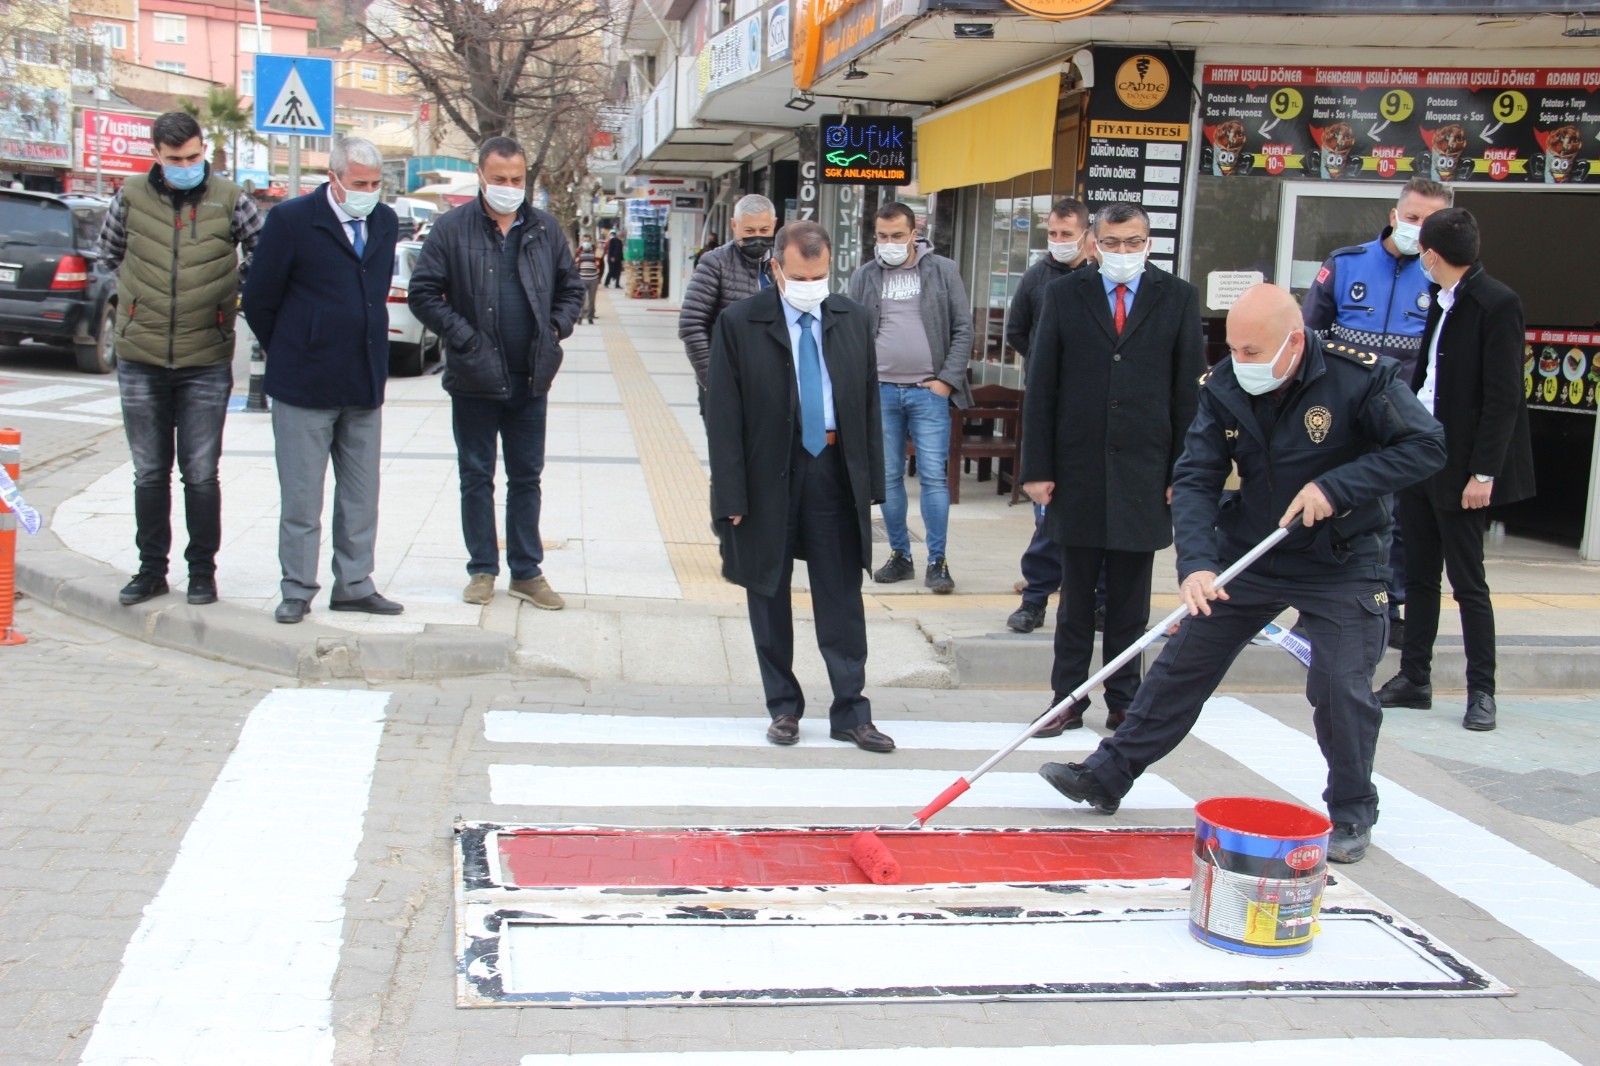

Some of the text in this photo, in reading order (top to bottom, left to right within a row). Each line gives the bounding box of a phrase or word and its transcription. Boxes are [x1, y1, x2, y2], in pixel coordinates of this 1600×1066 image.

[1211, 67, 1302, 83] HATAY USULÜ DÖNER
[1315, 67, 1418, 84] İSKENDERUN USULÜ DÖNER
[1426, 69, 1535, 86] ANTAKYA USULÜ DÖNER
[1546, 72, 1580, 86] ADANA
[1118, 81, 1166, 92] CADDE
[1207, 93, 1237, 103] Patates
[1245, 94, 1268, 104] Marul
[1275, 92, 1290, 114] 9
[1314, 95, 1336, 105] Patates
[1386, 93, 1401, 116] 9
[1426, 97, 1458, 106] Patates
[1541, 98, 1564, 108] Patates
[1499, 94, 1514, 118] 9
[1206, 107, 1220, 117] Sos
[1228, 107, 1262, 119] Mayonez
[1313, 109, 1330, 119] Marul
[1336, 109, 1345, 119] Sos
[1352, 109, 1378, 122] Mayonez
[1425, 110, 1461, 123] Mayonez
[1470, 112, 1484, 121] Sos
[1539, 112, 1558, 124] Soğan
[1564, 112, 1575, 122] Sos
[1097, 123, 1181, 137] FİYAT LİSTESİ
[1090, 144, 1115, 156] DÜRÜM
[1116, 144, 1139, 158] DÖNER
[1262, 147, 1293, 155] DUBLE
[1371, 148, 1404, 158] DUBLE
[1483, 150, 1518, 160] DUBLE
[868, 150, 905, 169] Optik
[1268, 158, 1277, 170] 10
[1379, 160, 1388, 172] 10
[825, 168, 905, 180] SGK ANLAŞMALIDIR
[1089, 164, 1112, 178] BÜTÜN
[1112, 166, 1136, 179] DÖNER
[1491, 162, 1500, 175] 10
[1094, 188, 1118, 202] BÜYÜK
[1118, 189, 1142, 203] DÖNER
